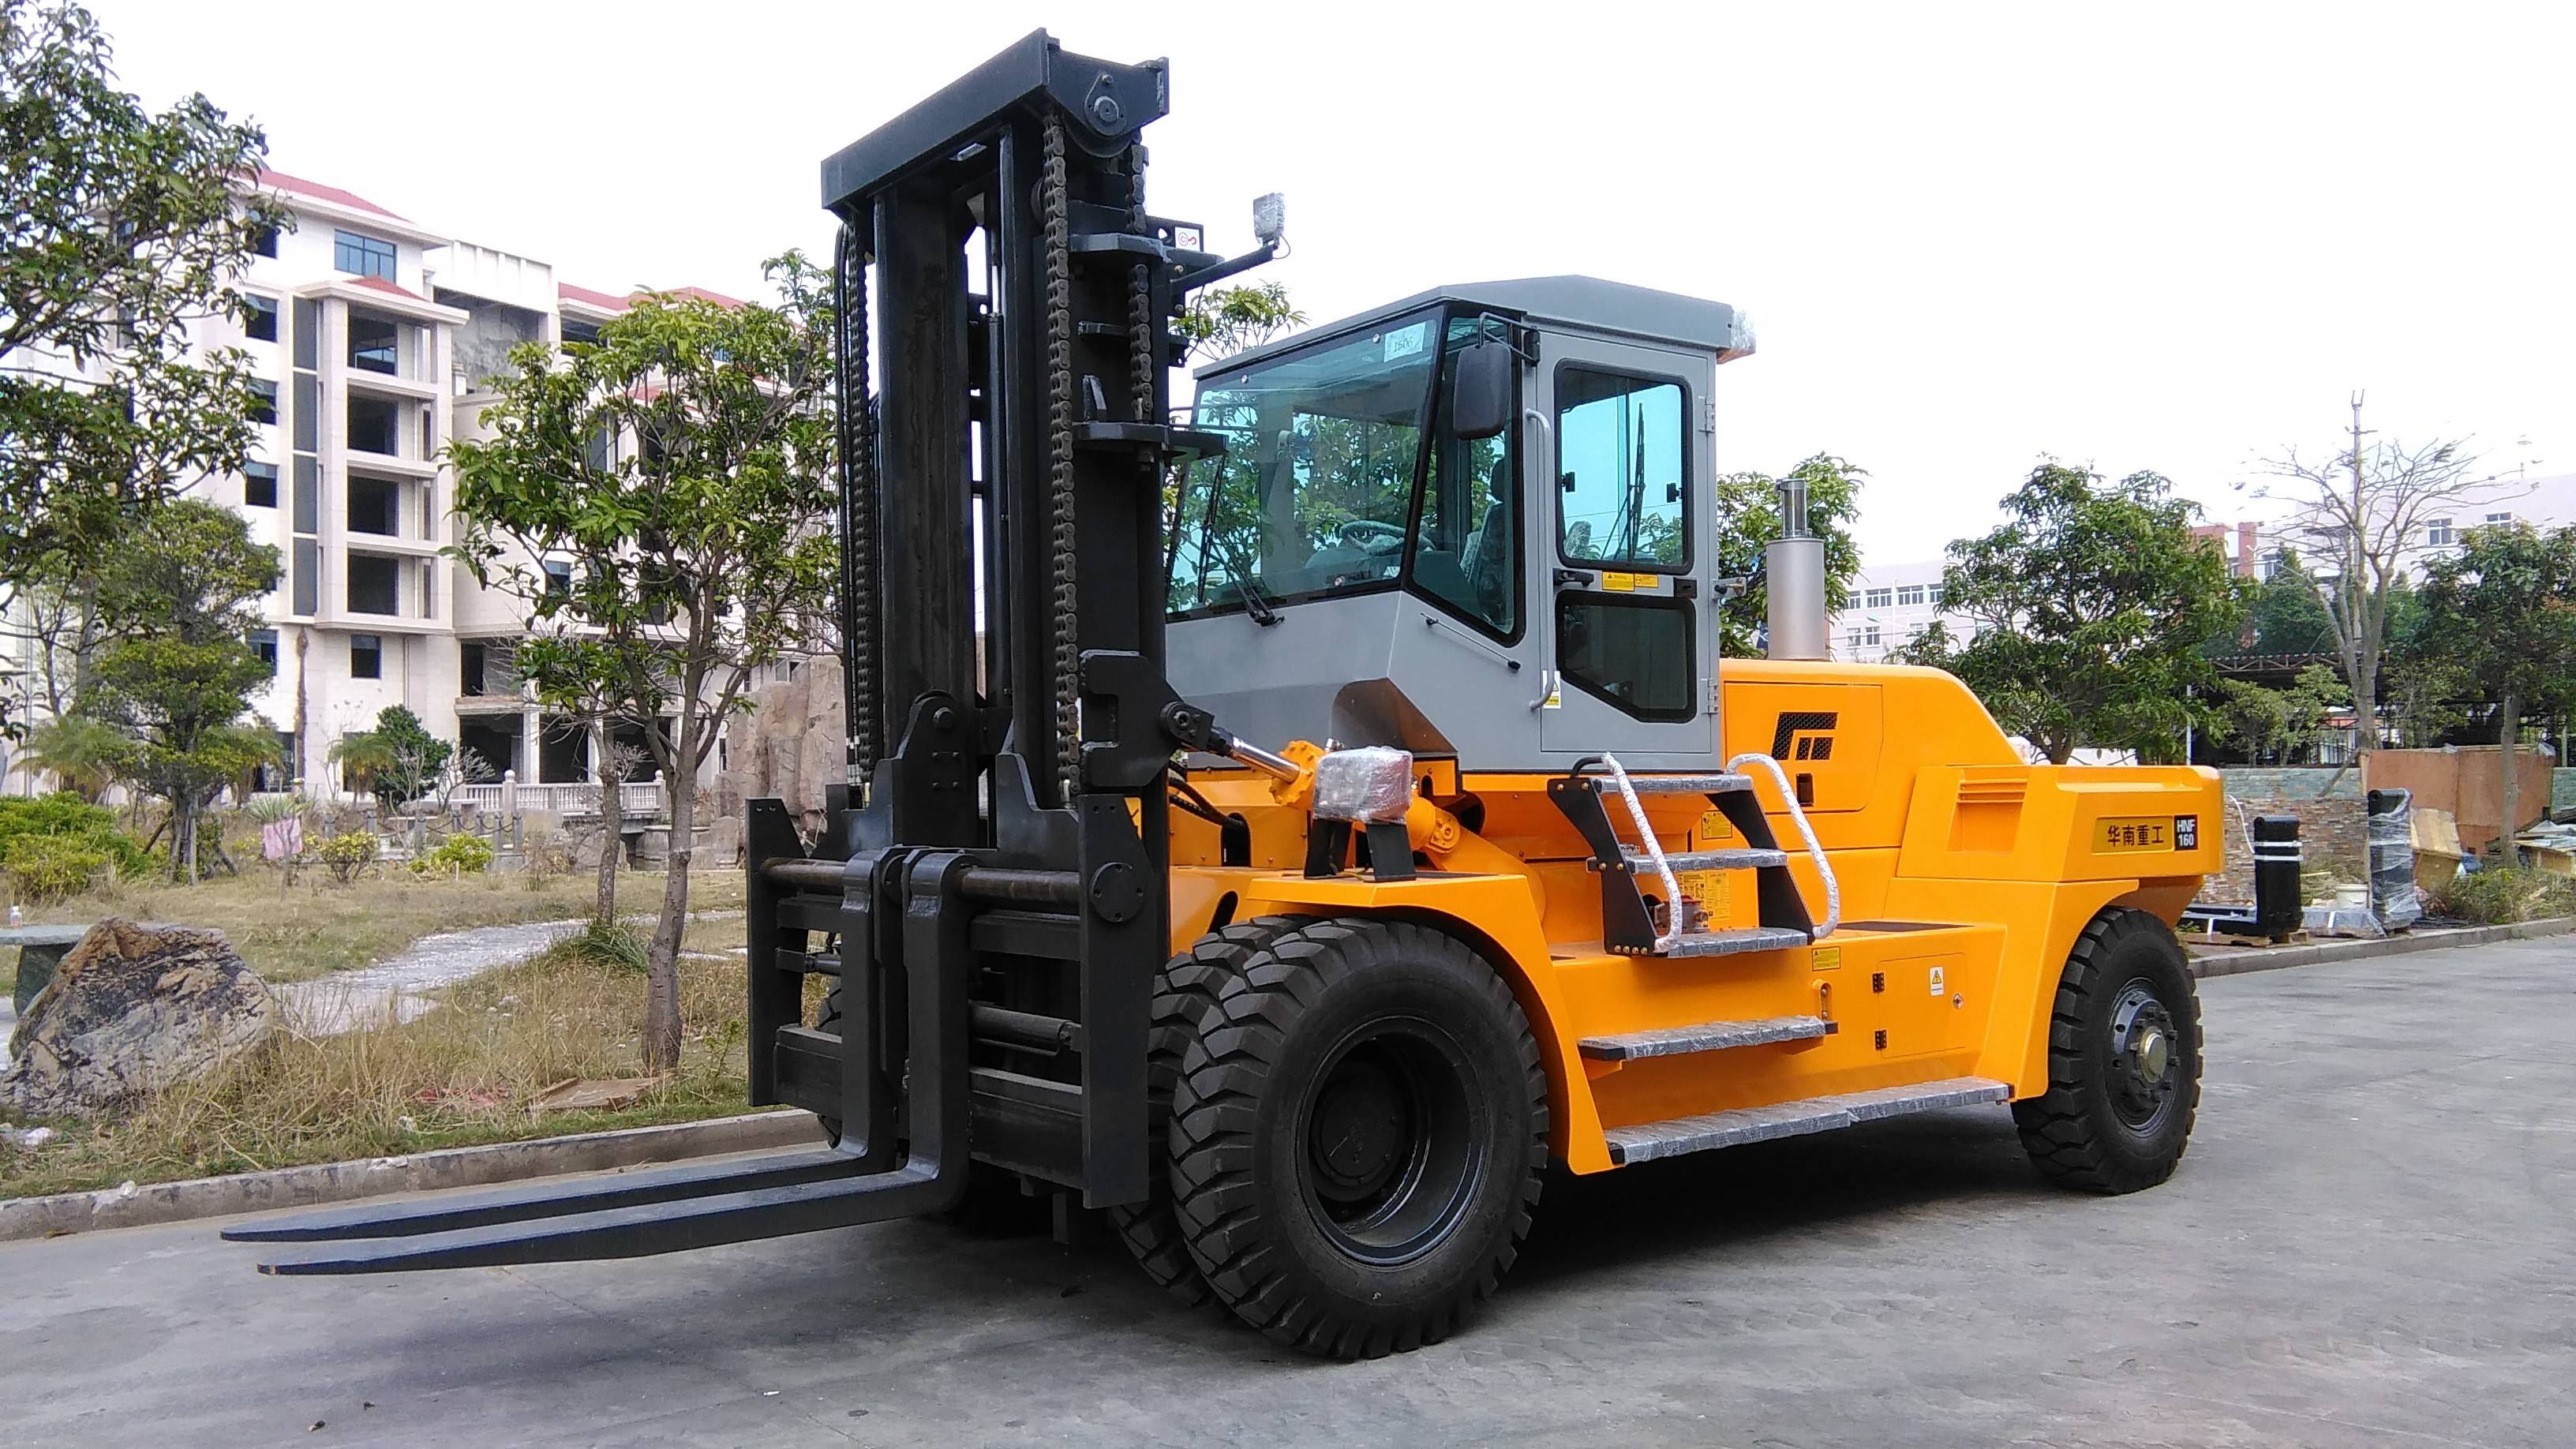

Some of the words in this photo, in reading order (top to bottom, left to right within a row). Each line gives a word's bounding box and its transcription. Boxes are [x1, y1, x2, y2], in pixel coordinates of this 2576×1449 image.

[2177, 819, 2195, 833] HNF
[2108, 824, 2164, 847] 华南重工
[2178, 833, 2194, 846] 160
